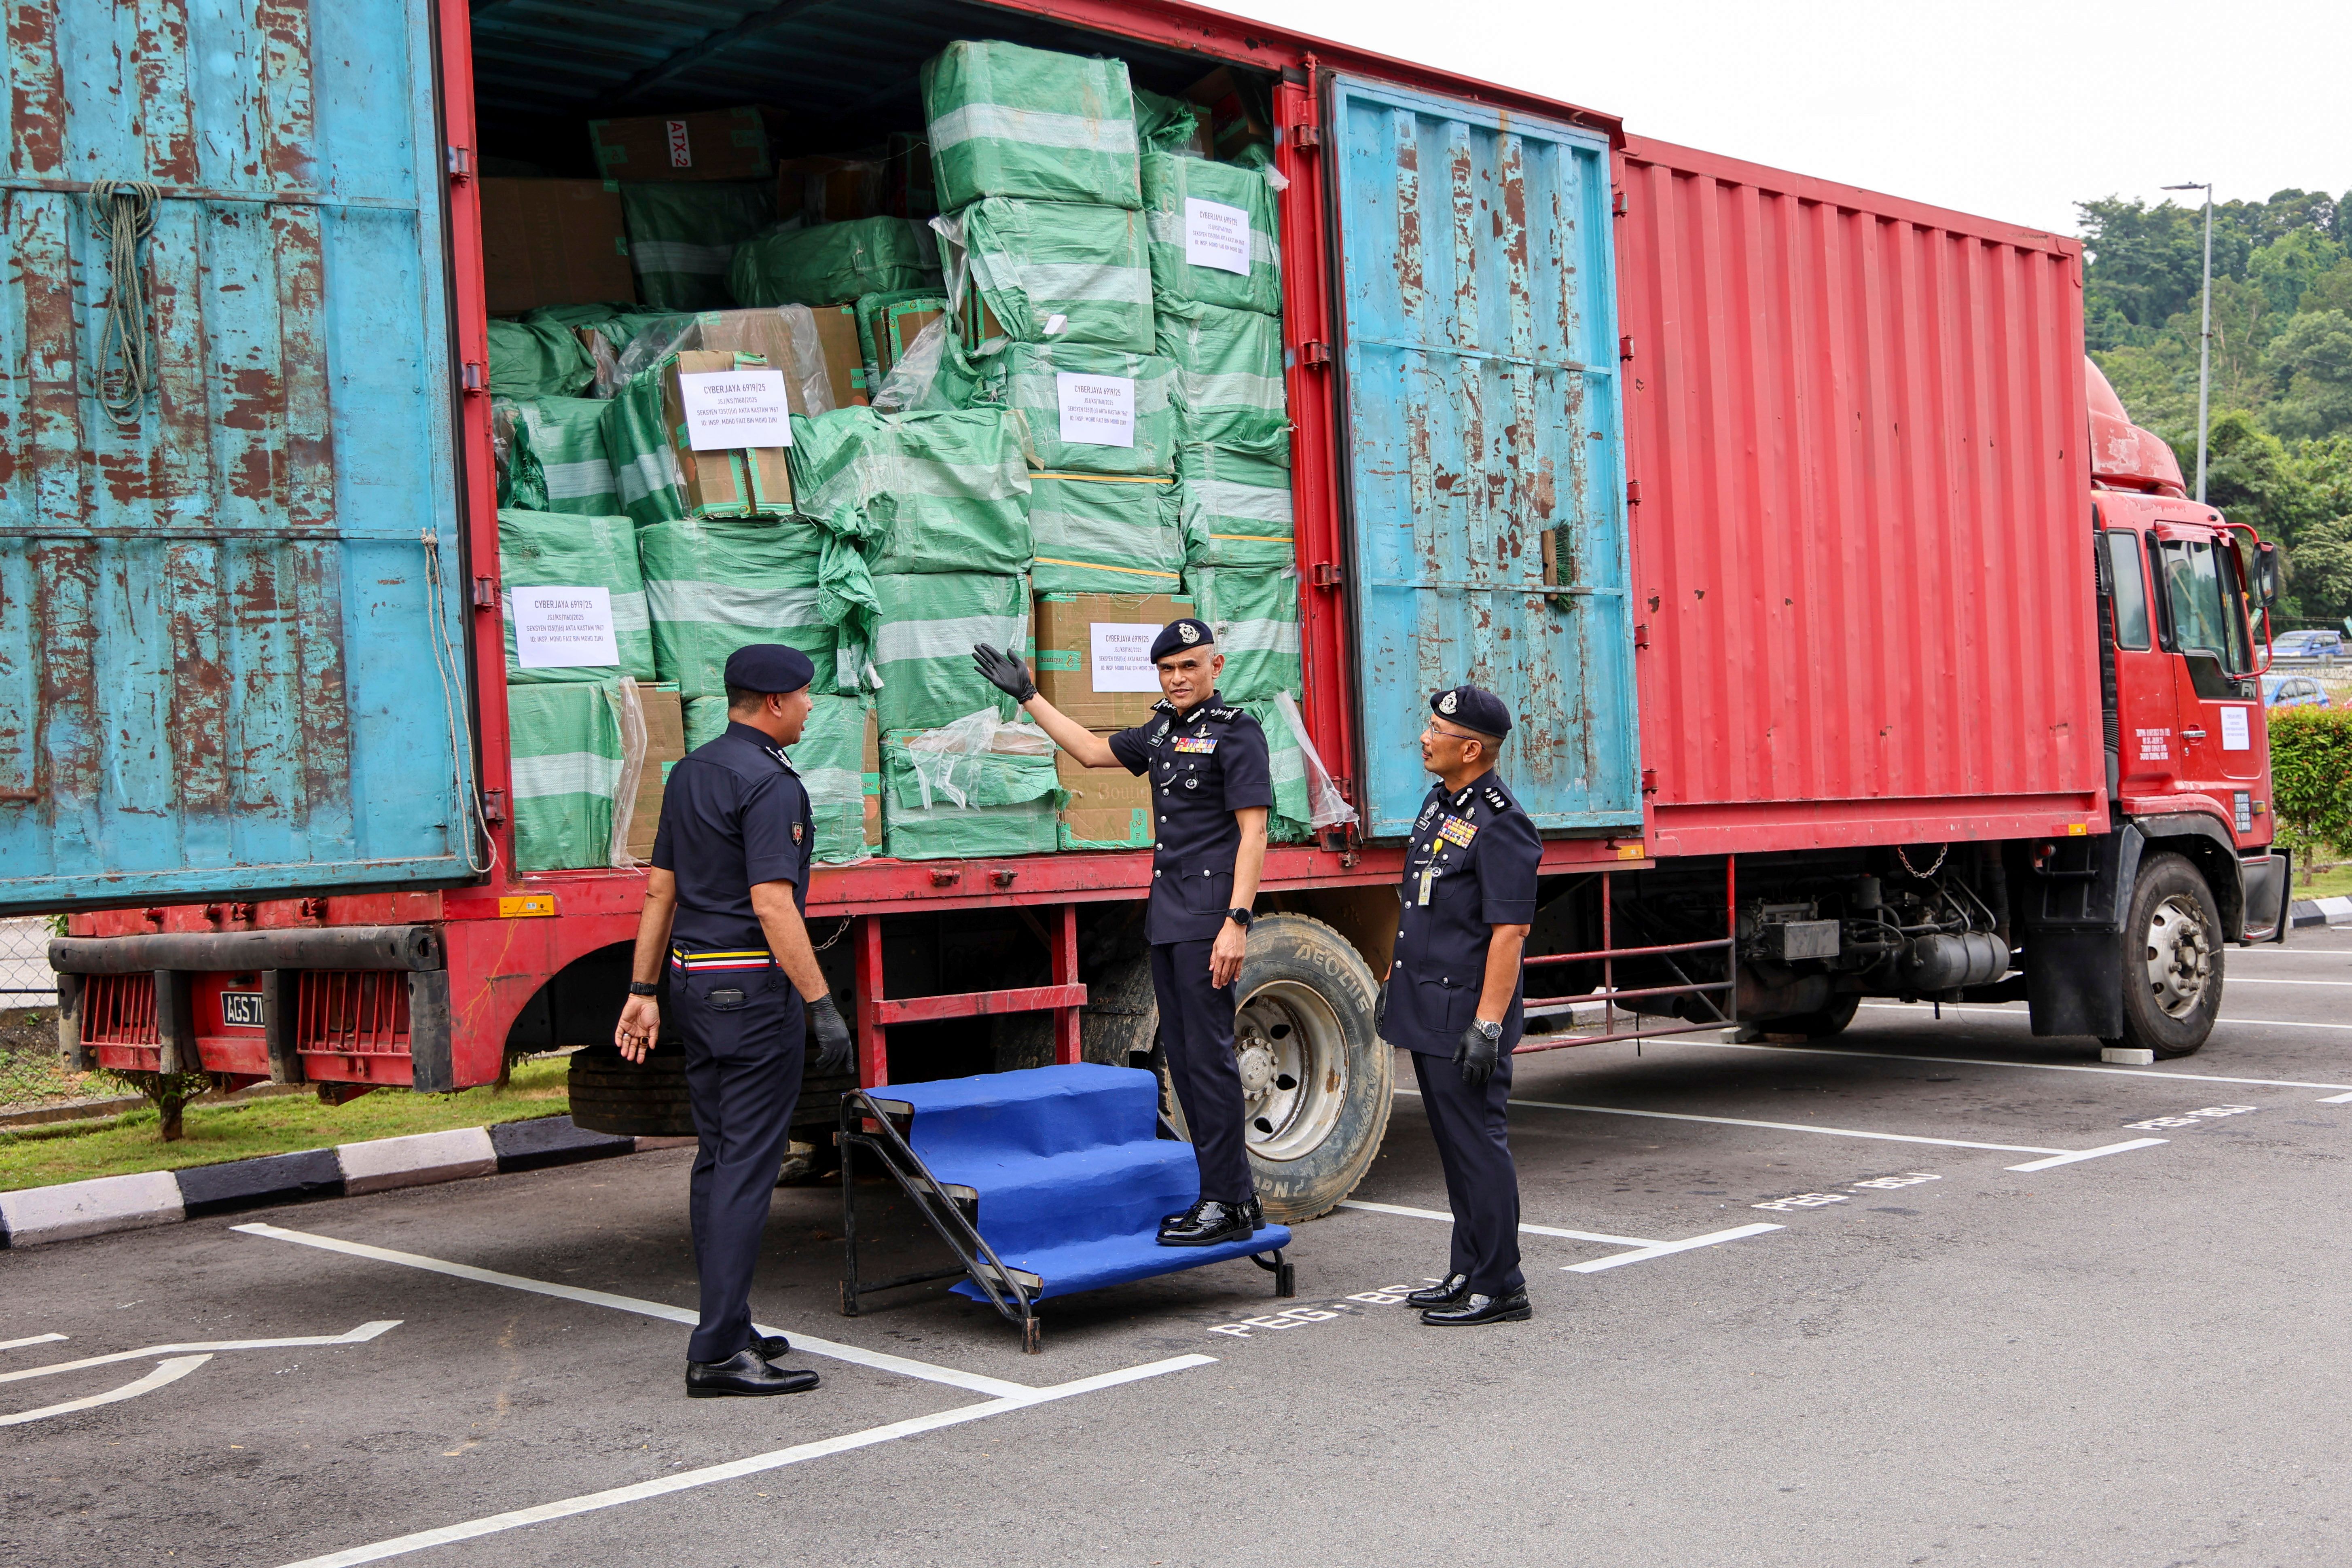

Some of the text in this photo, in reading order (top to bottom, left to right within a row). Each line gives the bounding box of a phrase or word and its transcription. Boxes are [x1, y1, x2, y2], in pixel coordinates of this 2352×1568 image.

[670, 122, 688, 166] ATX-2
[1200, 211, 1237, 226] CYBERJAYA 6919/25
[704, 383, 766, 394] CYBERJAYA 6919/25
[1075, 385, 1121, 396] CYBERJAYA 6919/25
[535, 600, 592, 609] CYBERJAYA 6919/25
[1040, 656, 1063, 665] Boutique
[1097, 782, 1150, 803] Boutiq
[1292, 944, 1370, 1014] AEOLUS
[228, 996, 250, 1022] AGS
